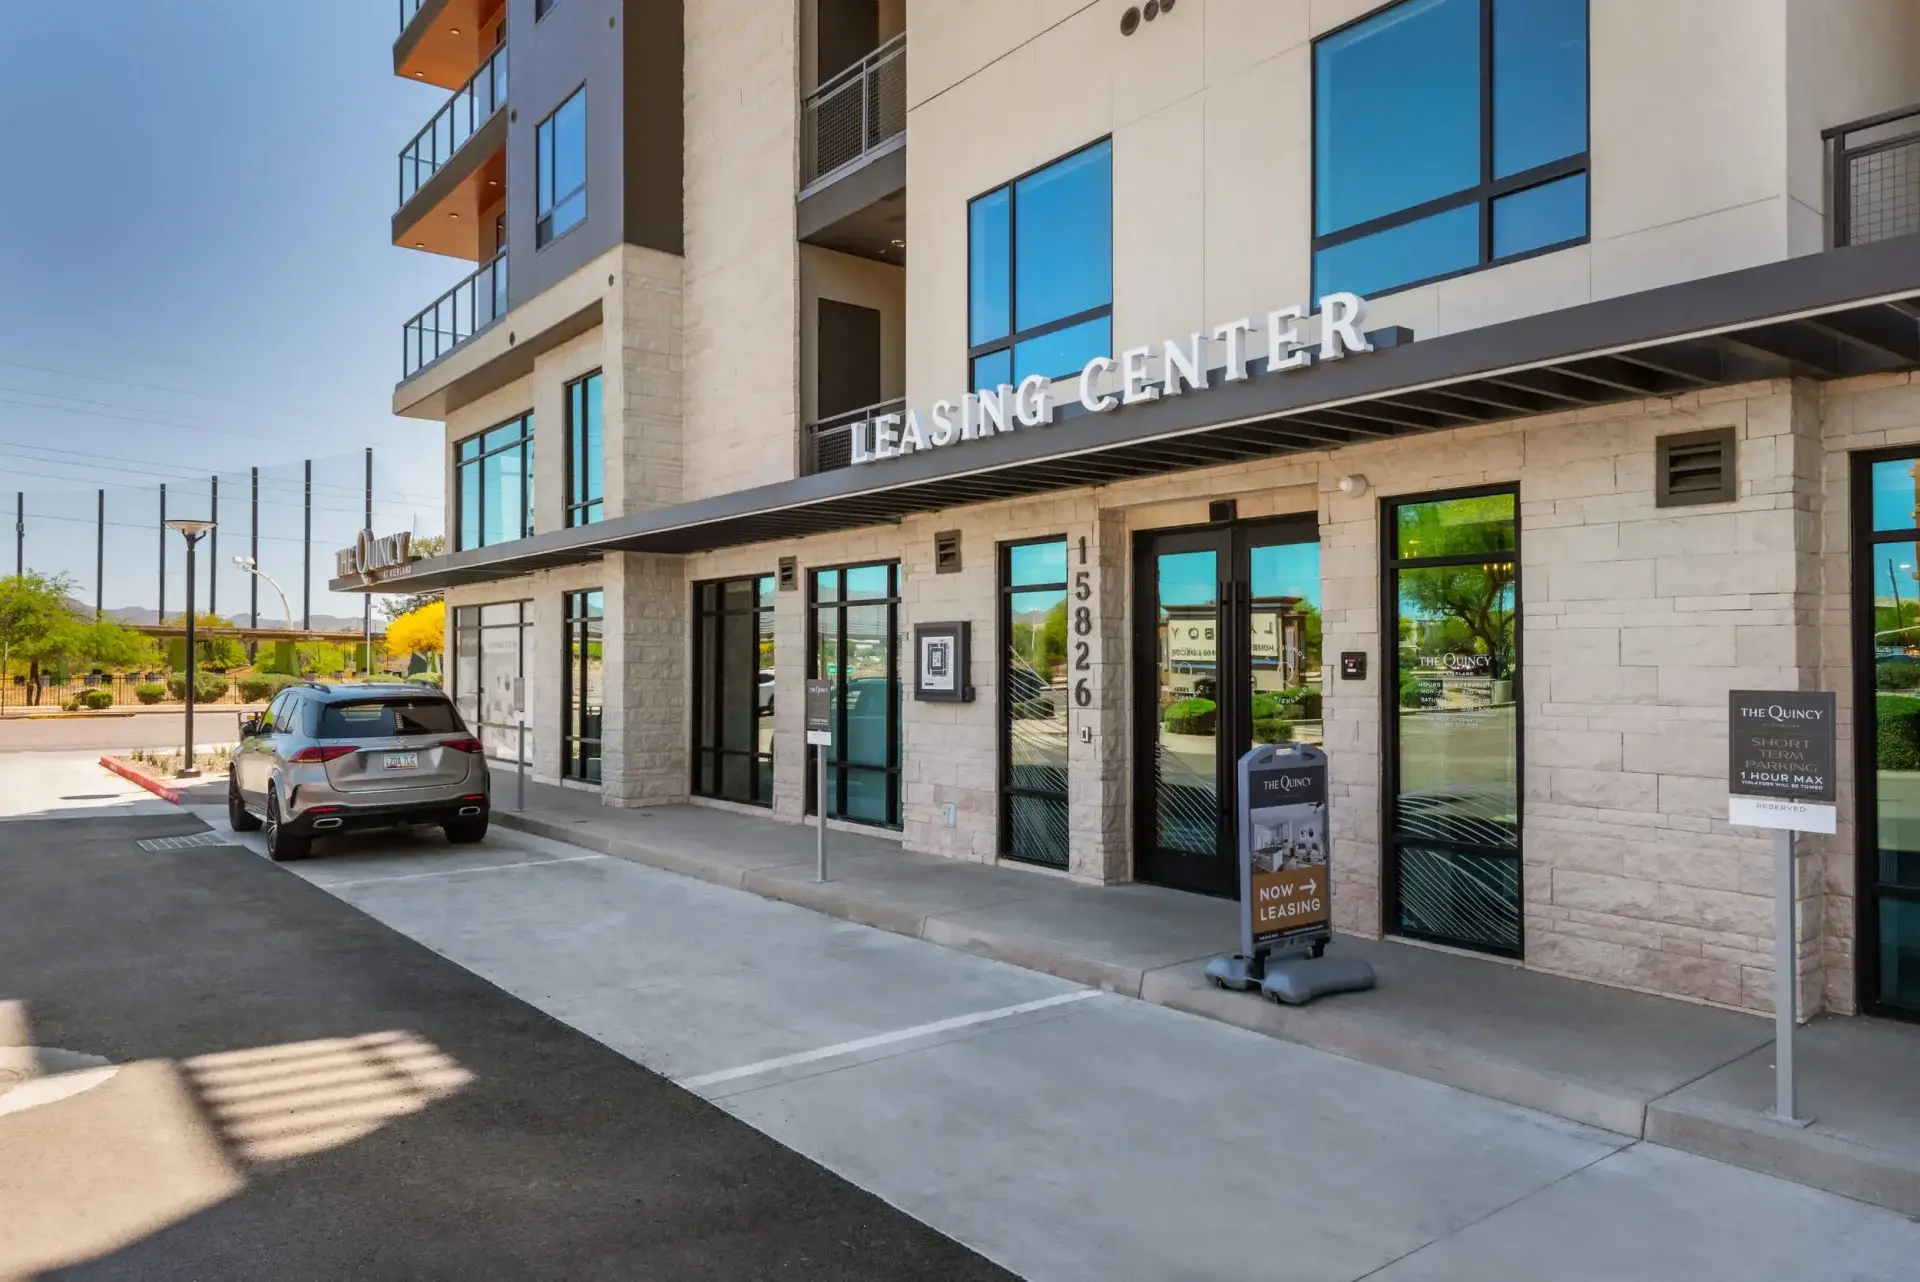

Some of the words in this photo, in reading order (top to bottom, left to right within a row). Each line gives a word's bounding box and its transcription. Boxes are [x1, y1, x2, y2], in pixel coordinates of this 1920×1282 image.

[850, 374, 1054, 466] LEASING
[1079, 292, 1374, 412] CENTER
[356, 529, 411, 586] QUINCY
[1075, 536, 1092, 707] 15826
[1419, 657, 1440, 666] THE
[1443, 652, 1492, 669] QUINCY
[1274, 686, 1308, 704] KIERLAND
[1741, 707, 1766, 718] THE
[1768, 705, 1823, 722] QUINCY
[1751, 737, 1814, 749] SHORT
[1758, 749, 1804, 760] TERM
[1745, 760, 1819, 773] PARKING
[1263, 780, 1279, 790] THE
[1280, 774, 1312, 792] QUINCY
[1751, 772, 1789, 783] HOUR
[1794, 775, 1823, 784] MAX
[1756, 803, 1806, 813] RESERVED
[1260, 883, 1294, 901] NOW
[1260, 898, 1321, 922] LEASING
